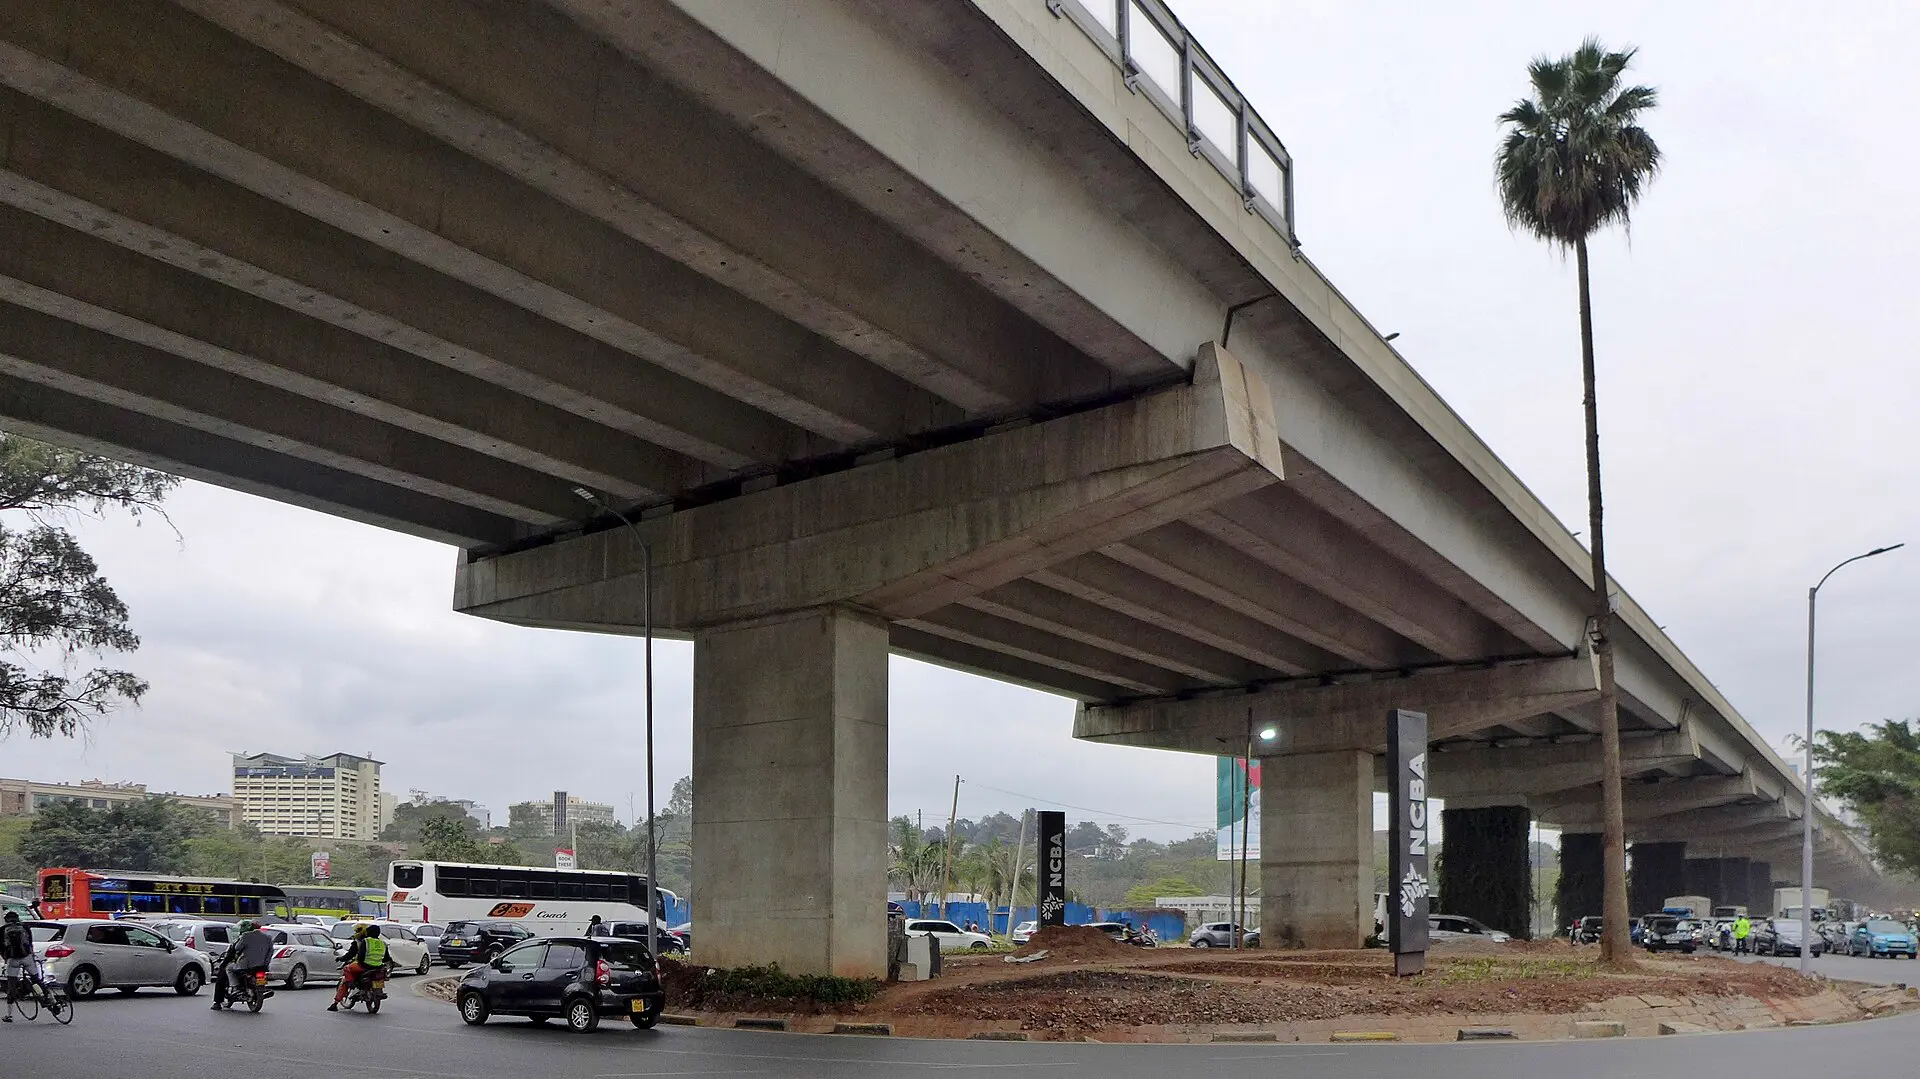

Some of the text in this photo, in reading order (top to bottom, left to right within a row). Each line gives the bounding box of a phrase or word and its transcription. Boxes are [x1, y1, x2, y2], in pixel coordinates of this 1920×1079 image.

[1409, 752, 1426, 855] NCBA
[1050, 833, 1062, 886] NCBA
[536, 911, 567, 919] Coach
